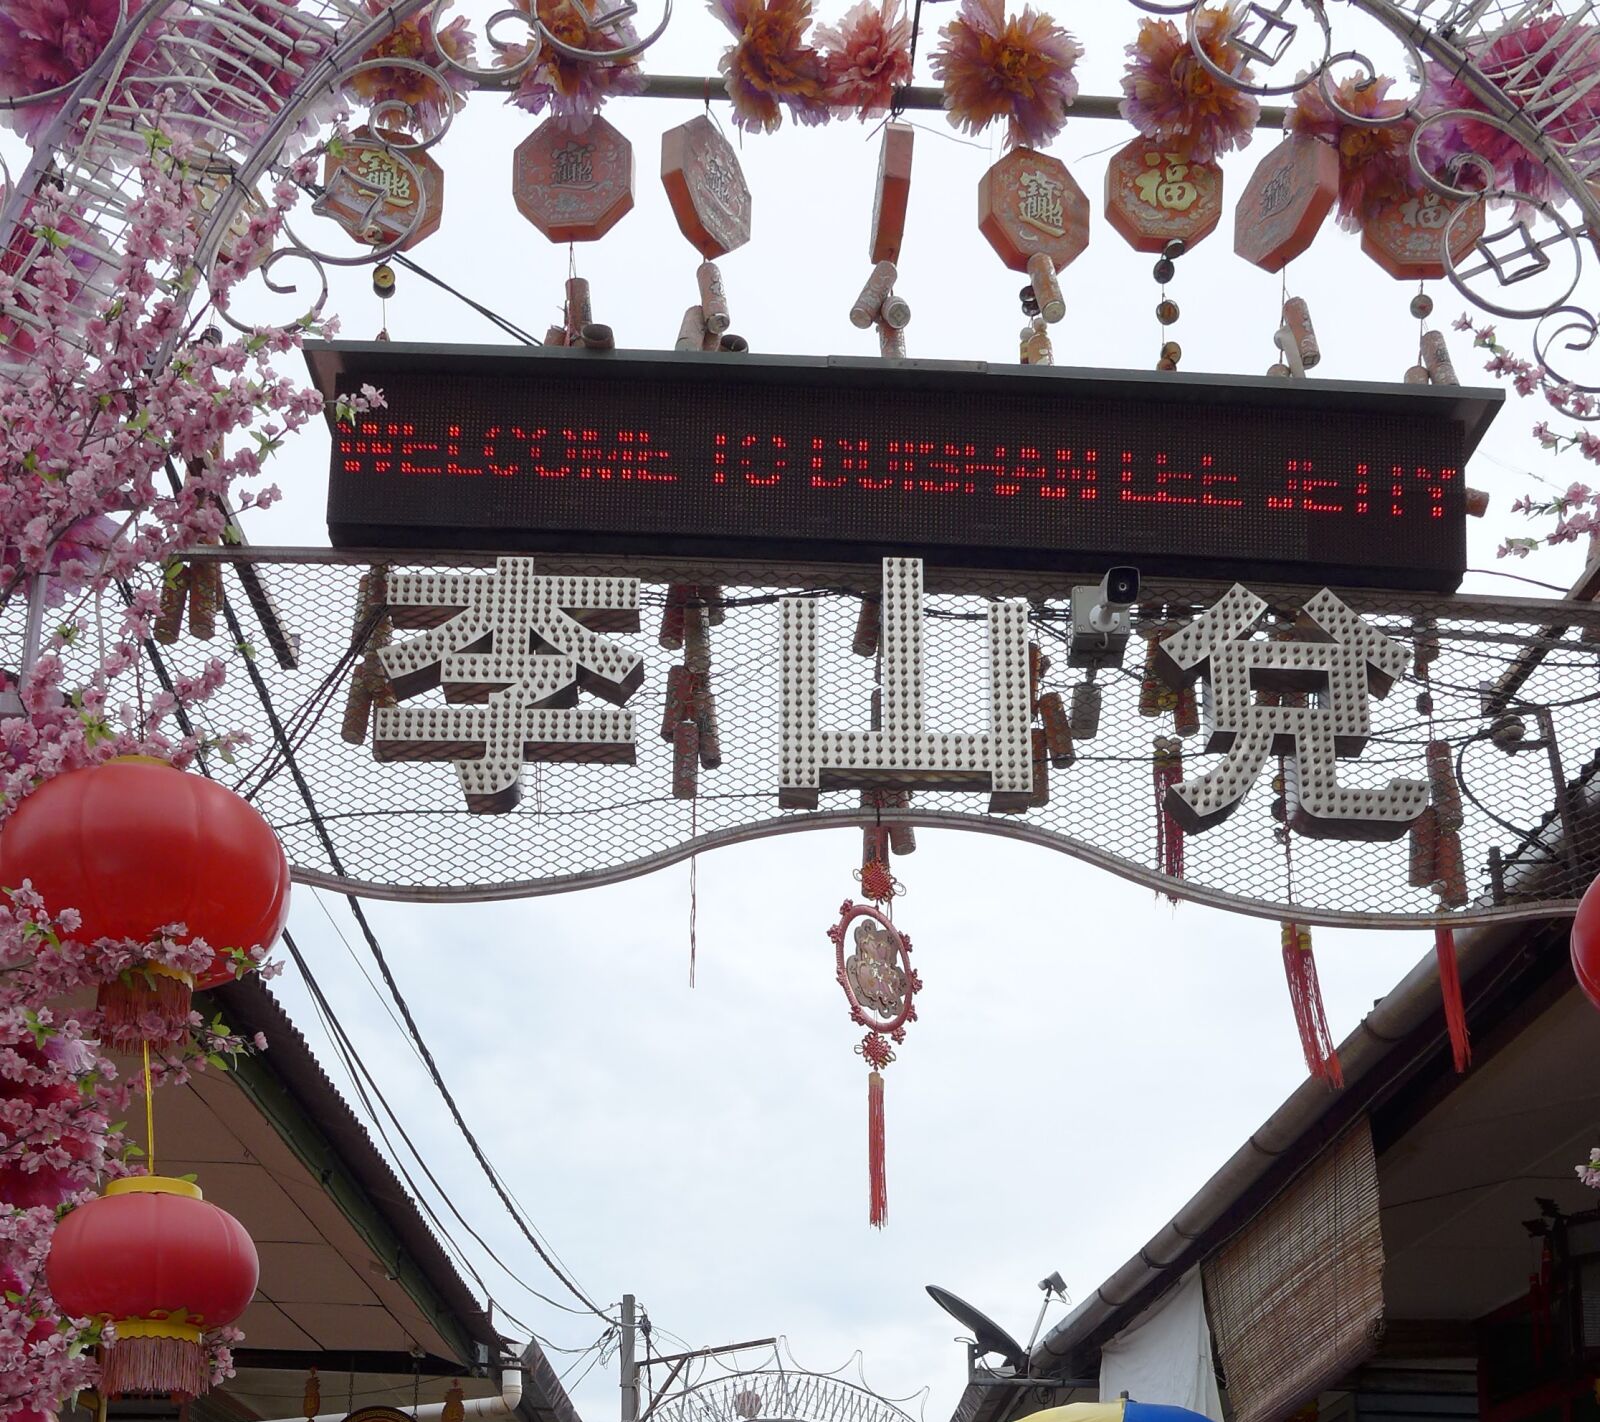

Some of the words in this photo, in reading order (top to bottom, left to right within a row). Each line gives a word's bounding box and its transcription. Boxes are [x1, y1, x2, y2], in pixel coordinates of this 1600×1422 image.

[1135, 152, 1197, 211] 福
[338, 422, 677, 481] WELCOME
[1121, 452, 1242, 506] LEE
